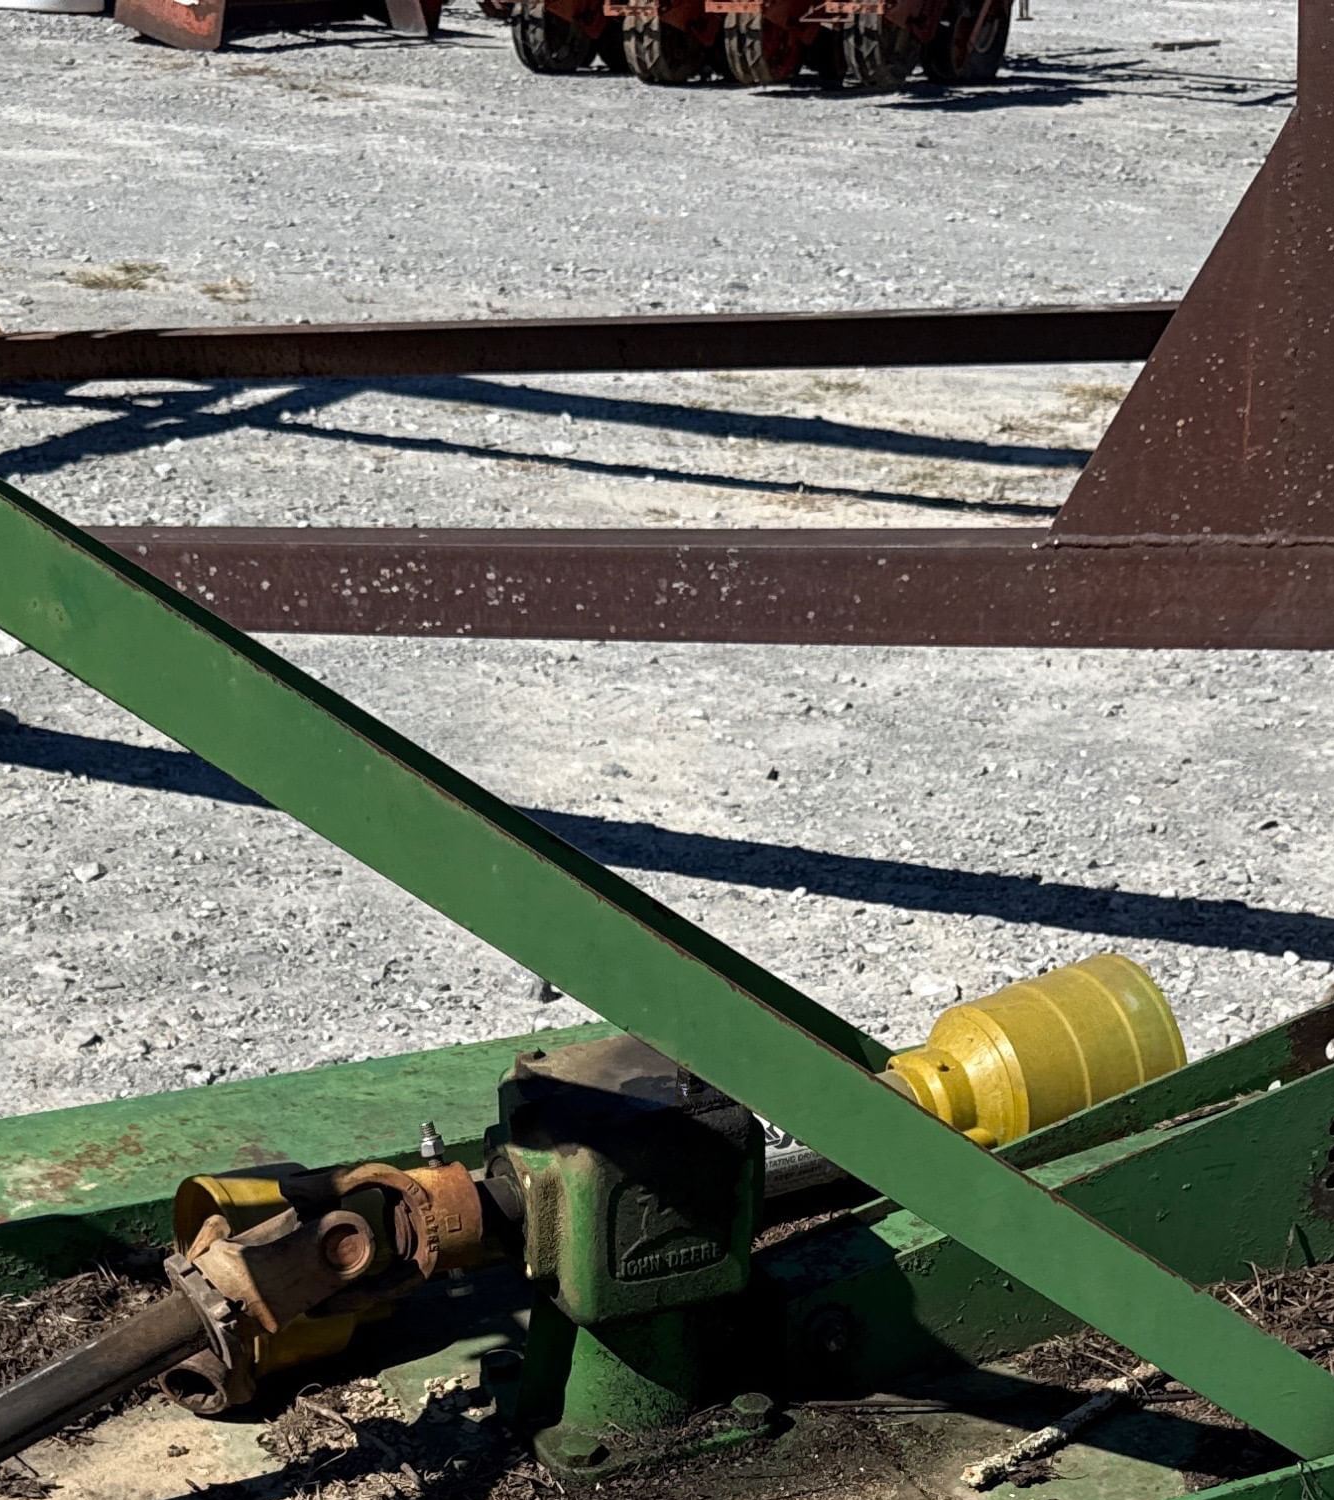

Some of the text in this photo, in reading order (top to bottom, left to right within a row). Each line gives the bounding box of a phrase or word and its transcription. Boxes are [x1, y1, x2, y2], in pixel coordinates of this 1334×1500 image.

[765, 1155, 796, 1168] TATING
[616, 1242, 722, 1278] JOHN DEERE
